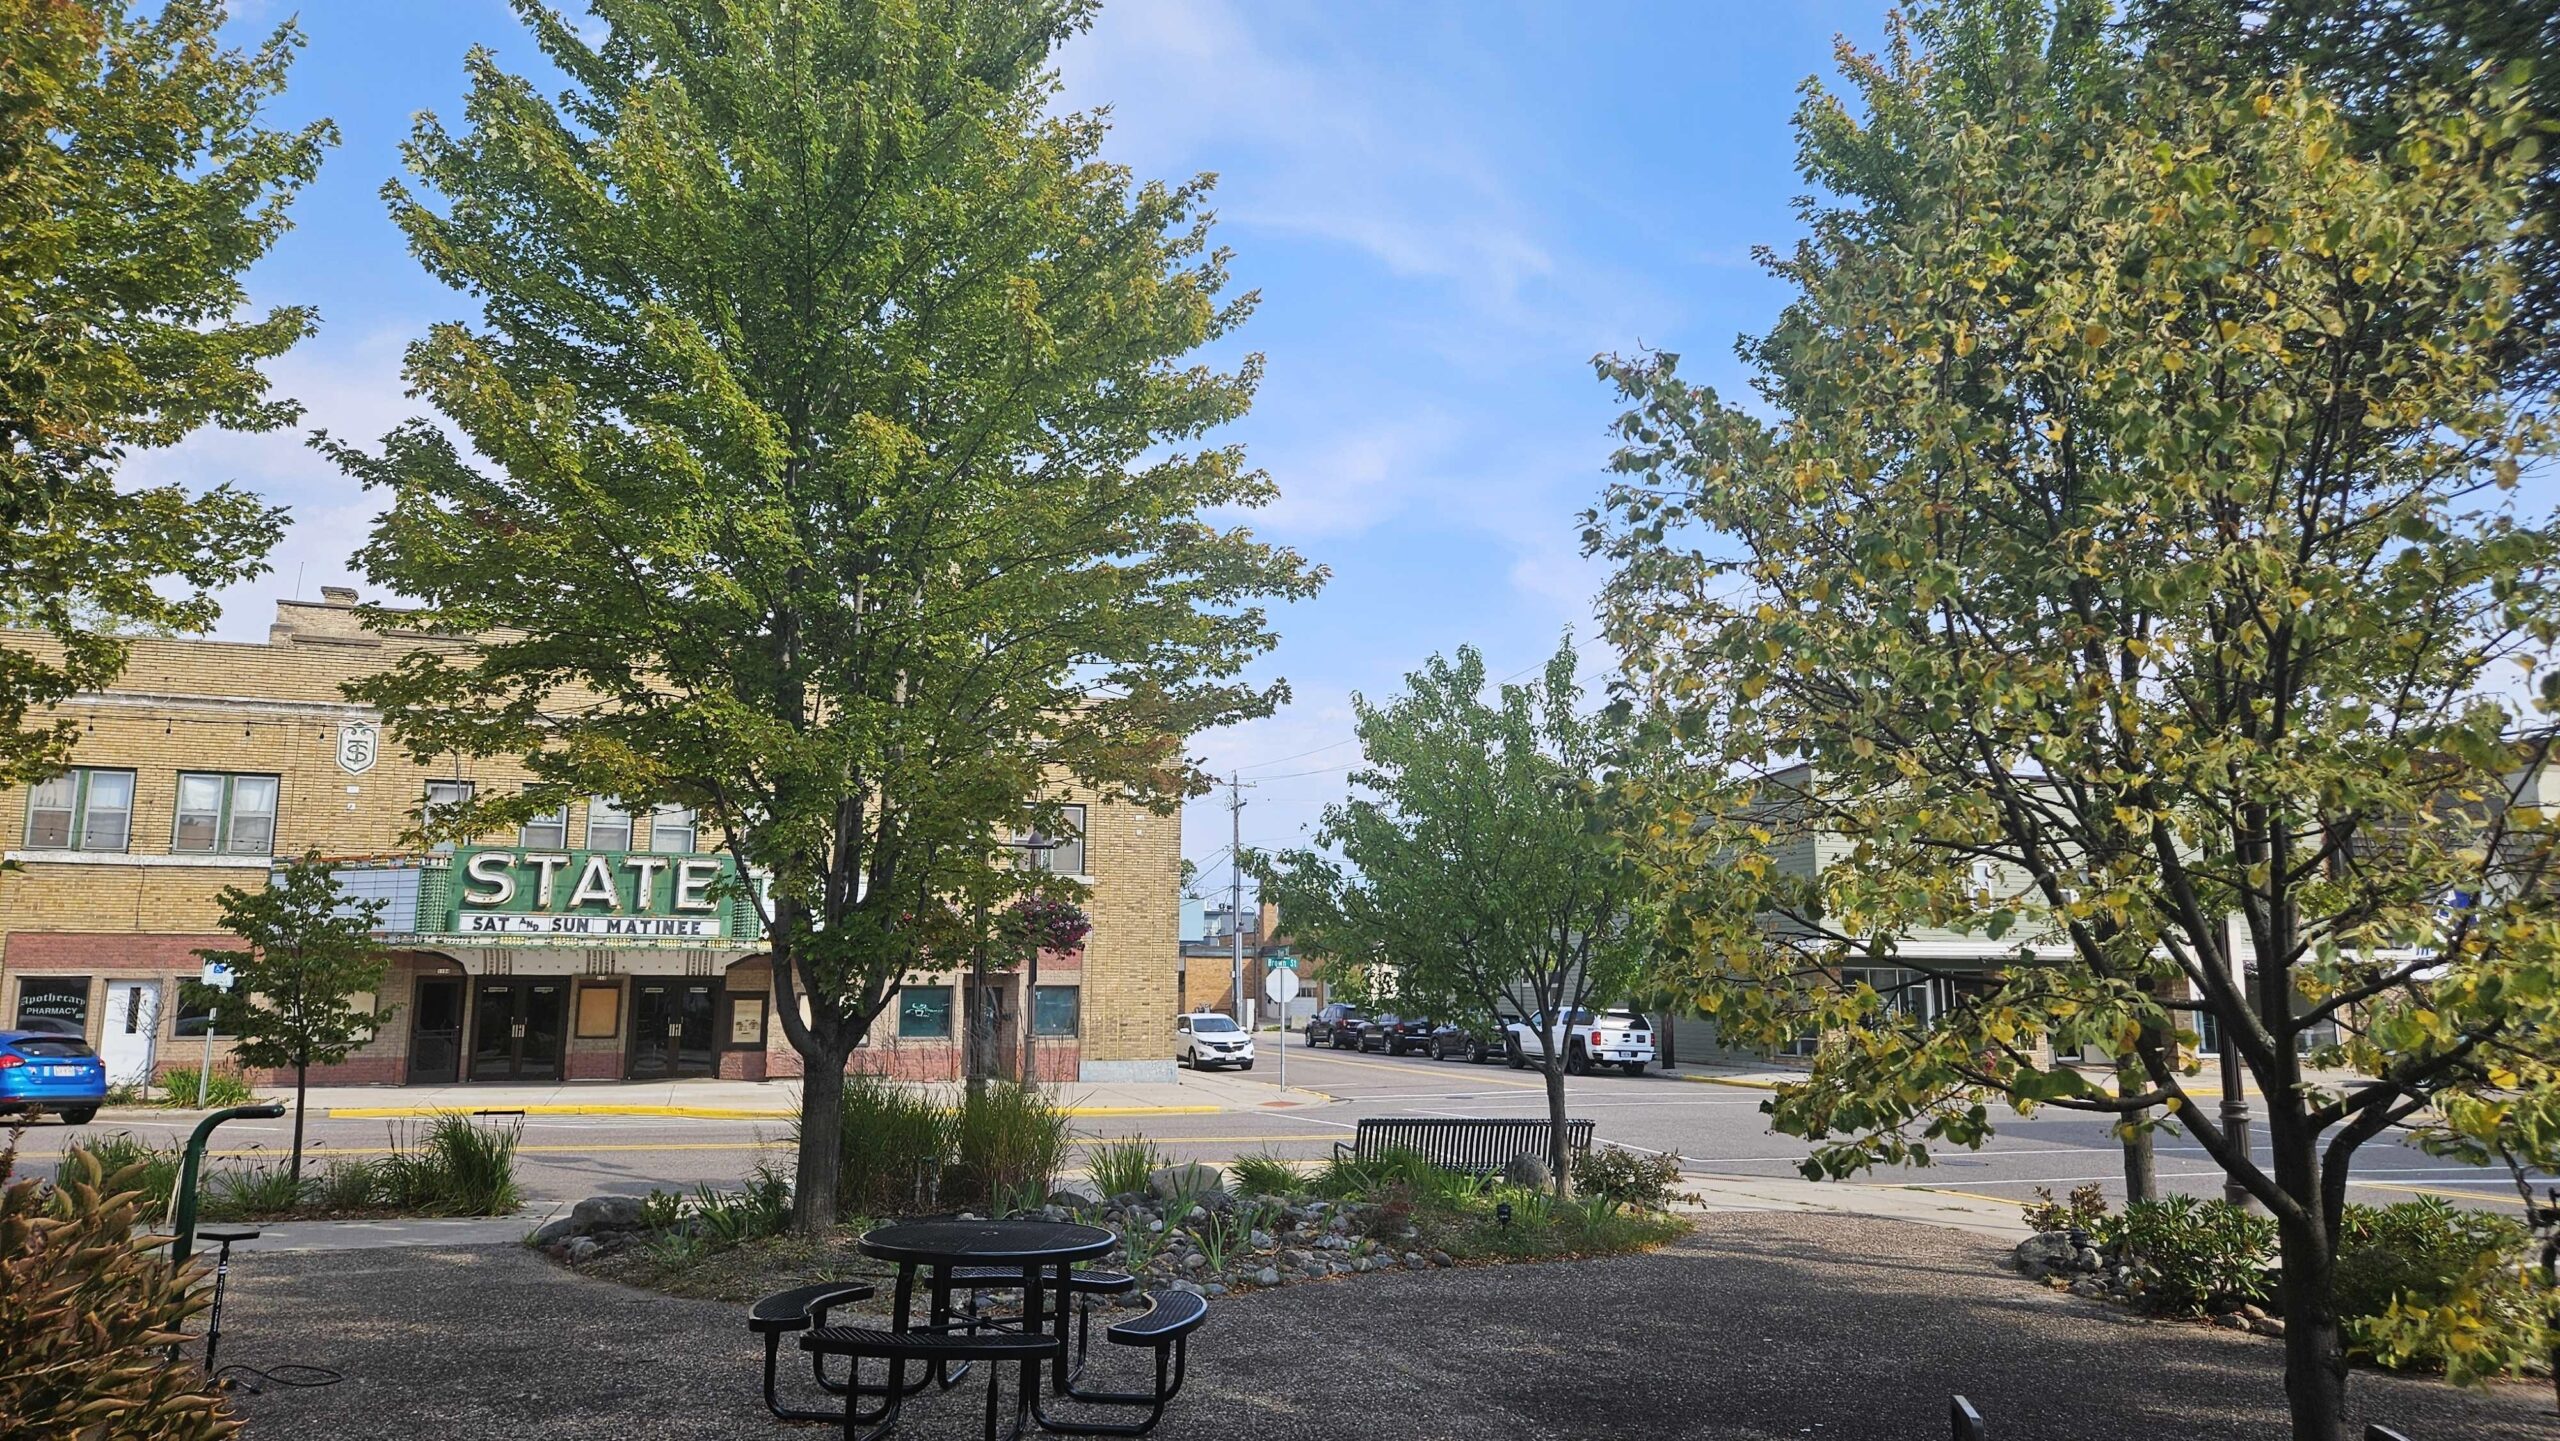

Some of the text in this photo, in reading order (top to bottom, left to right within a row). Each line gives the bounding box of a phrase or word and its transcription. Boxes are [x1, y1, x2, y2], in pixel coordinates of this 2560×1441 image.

[464, 851, 724, 911] STATE
[473, 916, 701, 935] SAT AND SUN MATINEE
[1267, 958, 1297, 967] Brown St
[20, 993, 86, 1006] Apothecary
[26, 1007, 78, 1015] PHARMACY
